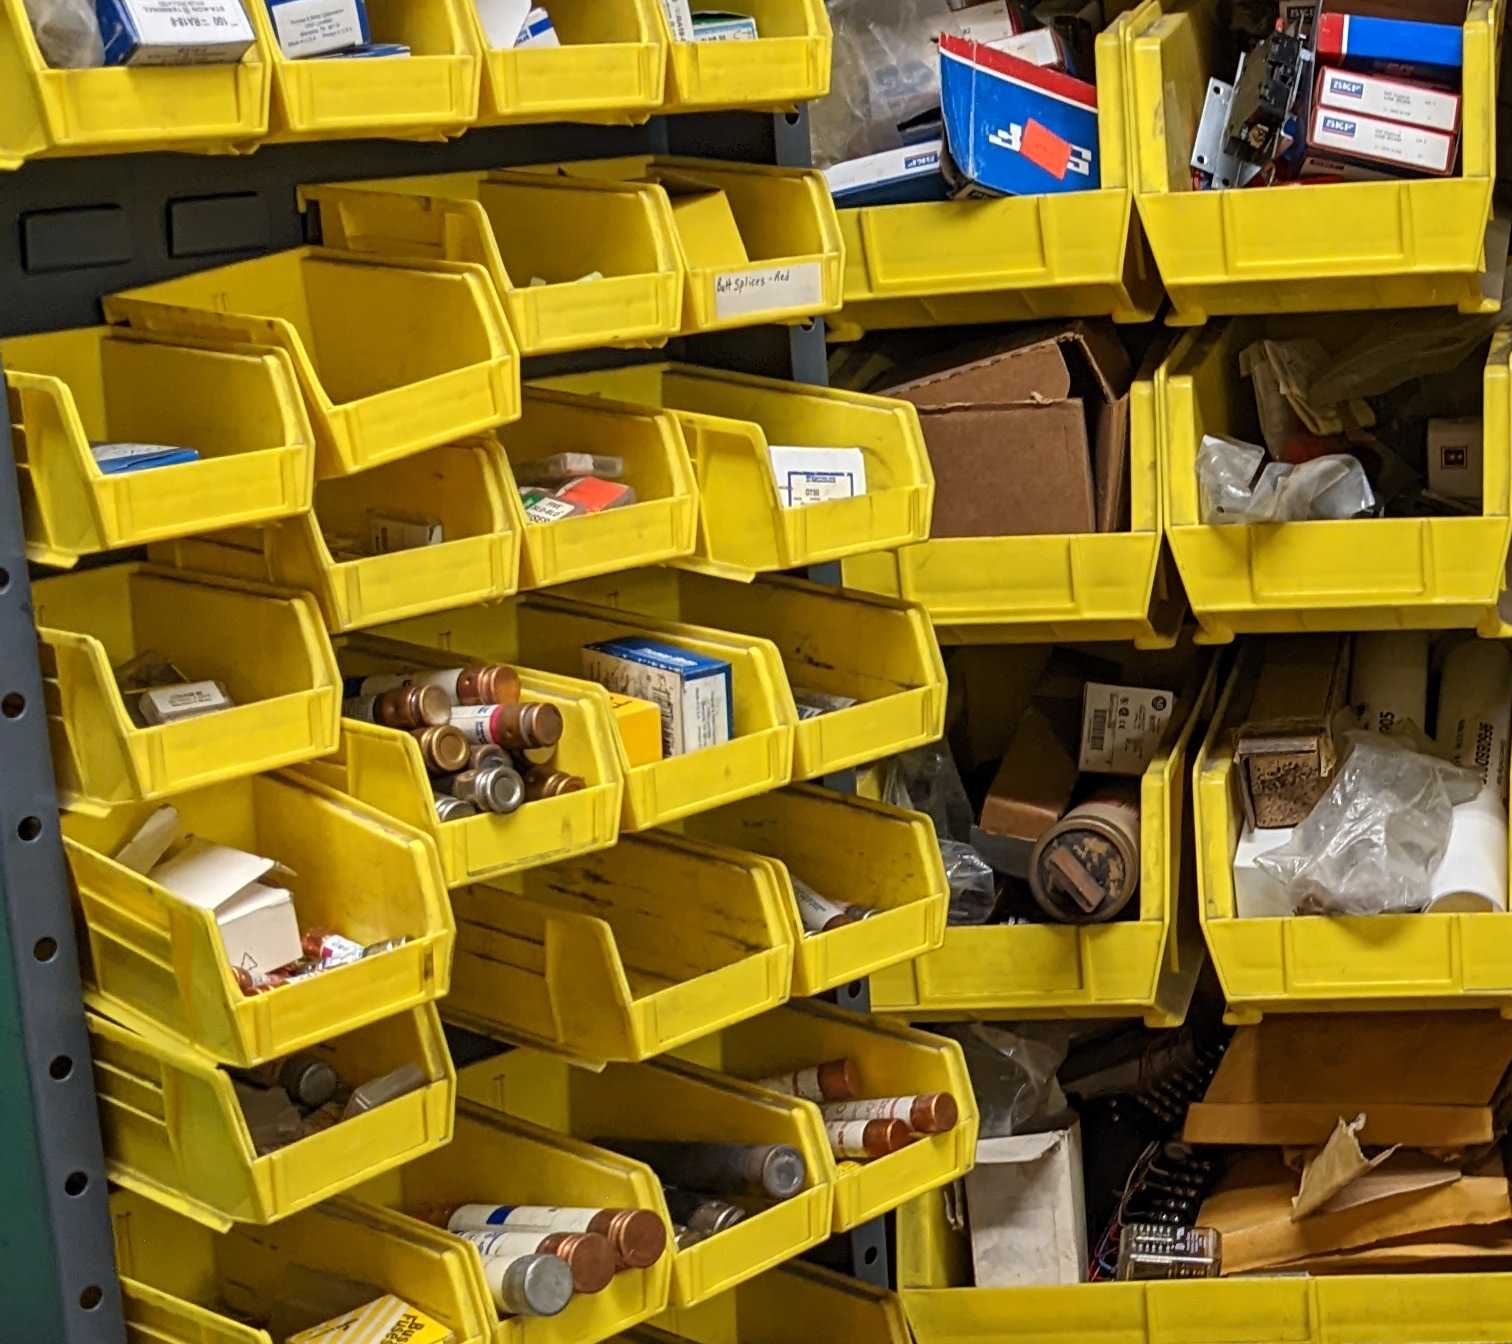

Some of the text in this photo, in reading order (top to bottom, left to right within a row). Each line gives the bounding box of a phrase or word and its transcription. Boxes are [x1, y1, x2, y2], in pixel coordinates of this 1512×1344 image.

[1333, 80, 1361, 93] SKF
[1325, 118, 1354, 132] SKF
[989, 122, 1092, 177] SF
[735, 277, 766, 293] Splices
